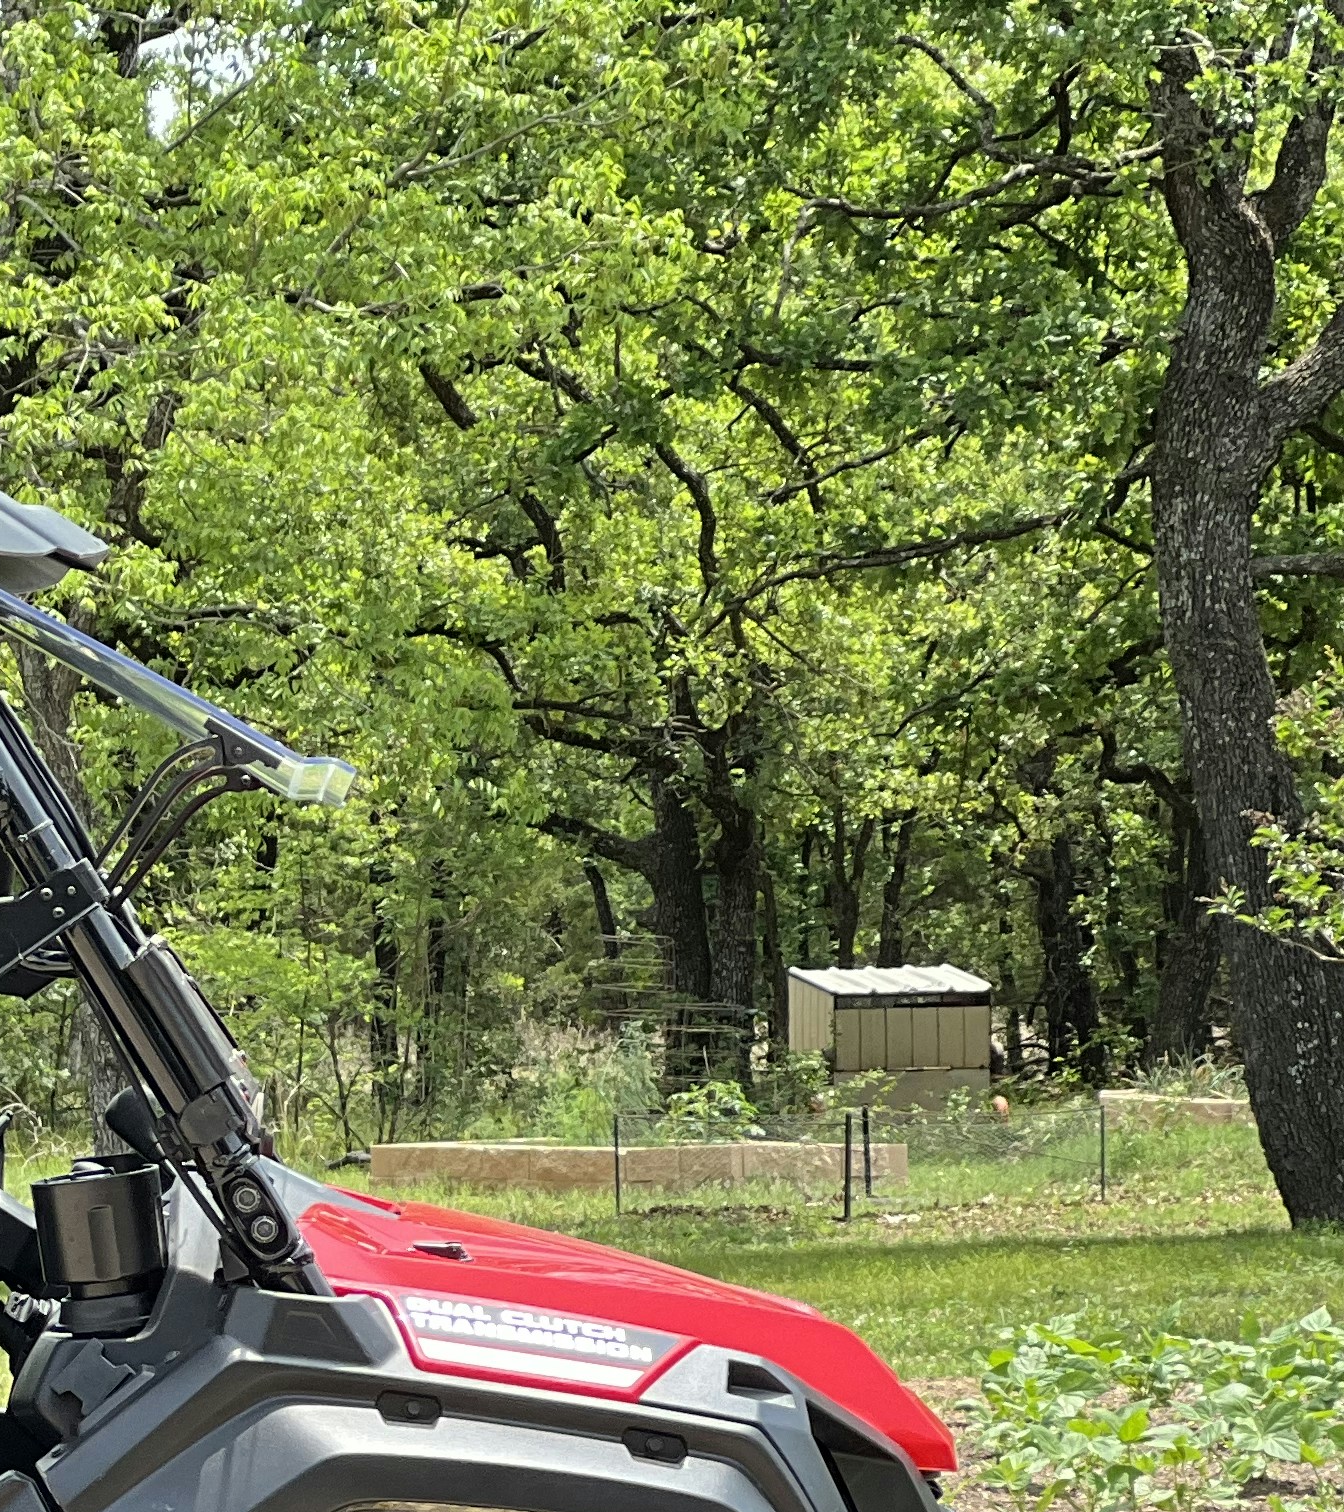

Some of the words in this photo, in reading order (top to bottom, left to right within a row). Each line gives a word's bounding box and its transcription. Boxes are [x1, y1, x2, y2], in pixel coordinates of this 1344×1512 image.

[406, 1296, 492, 1321] DUAL
[500, 1309, 626, 1342] CLUTCH
[410, 1311, 653, 1362] TRANSMISSION
